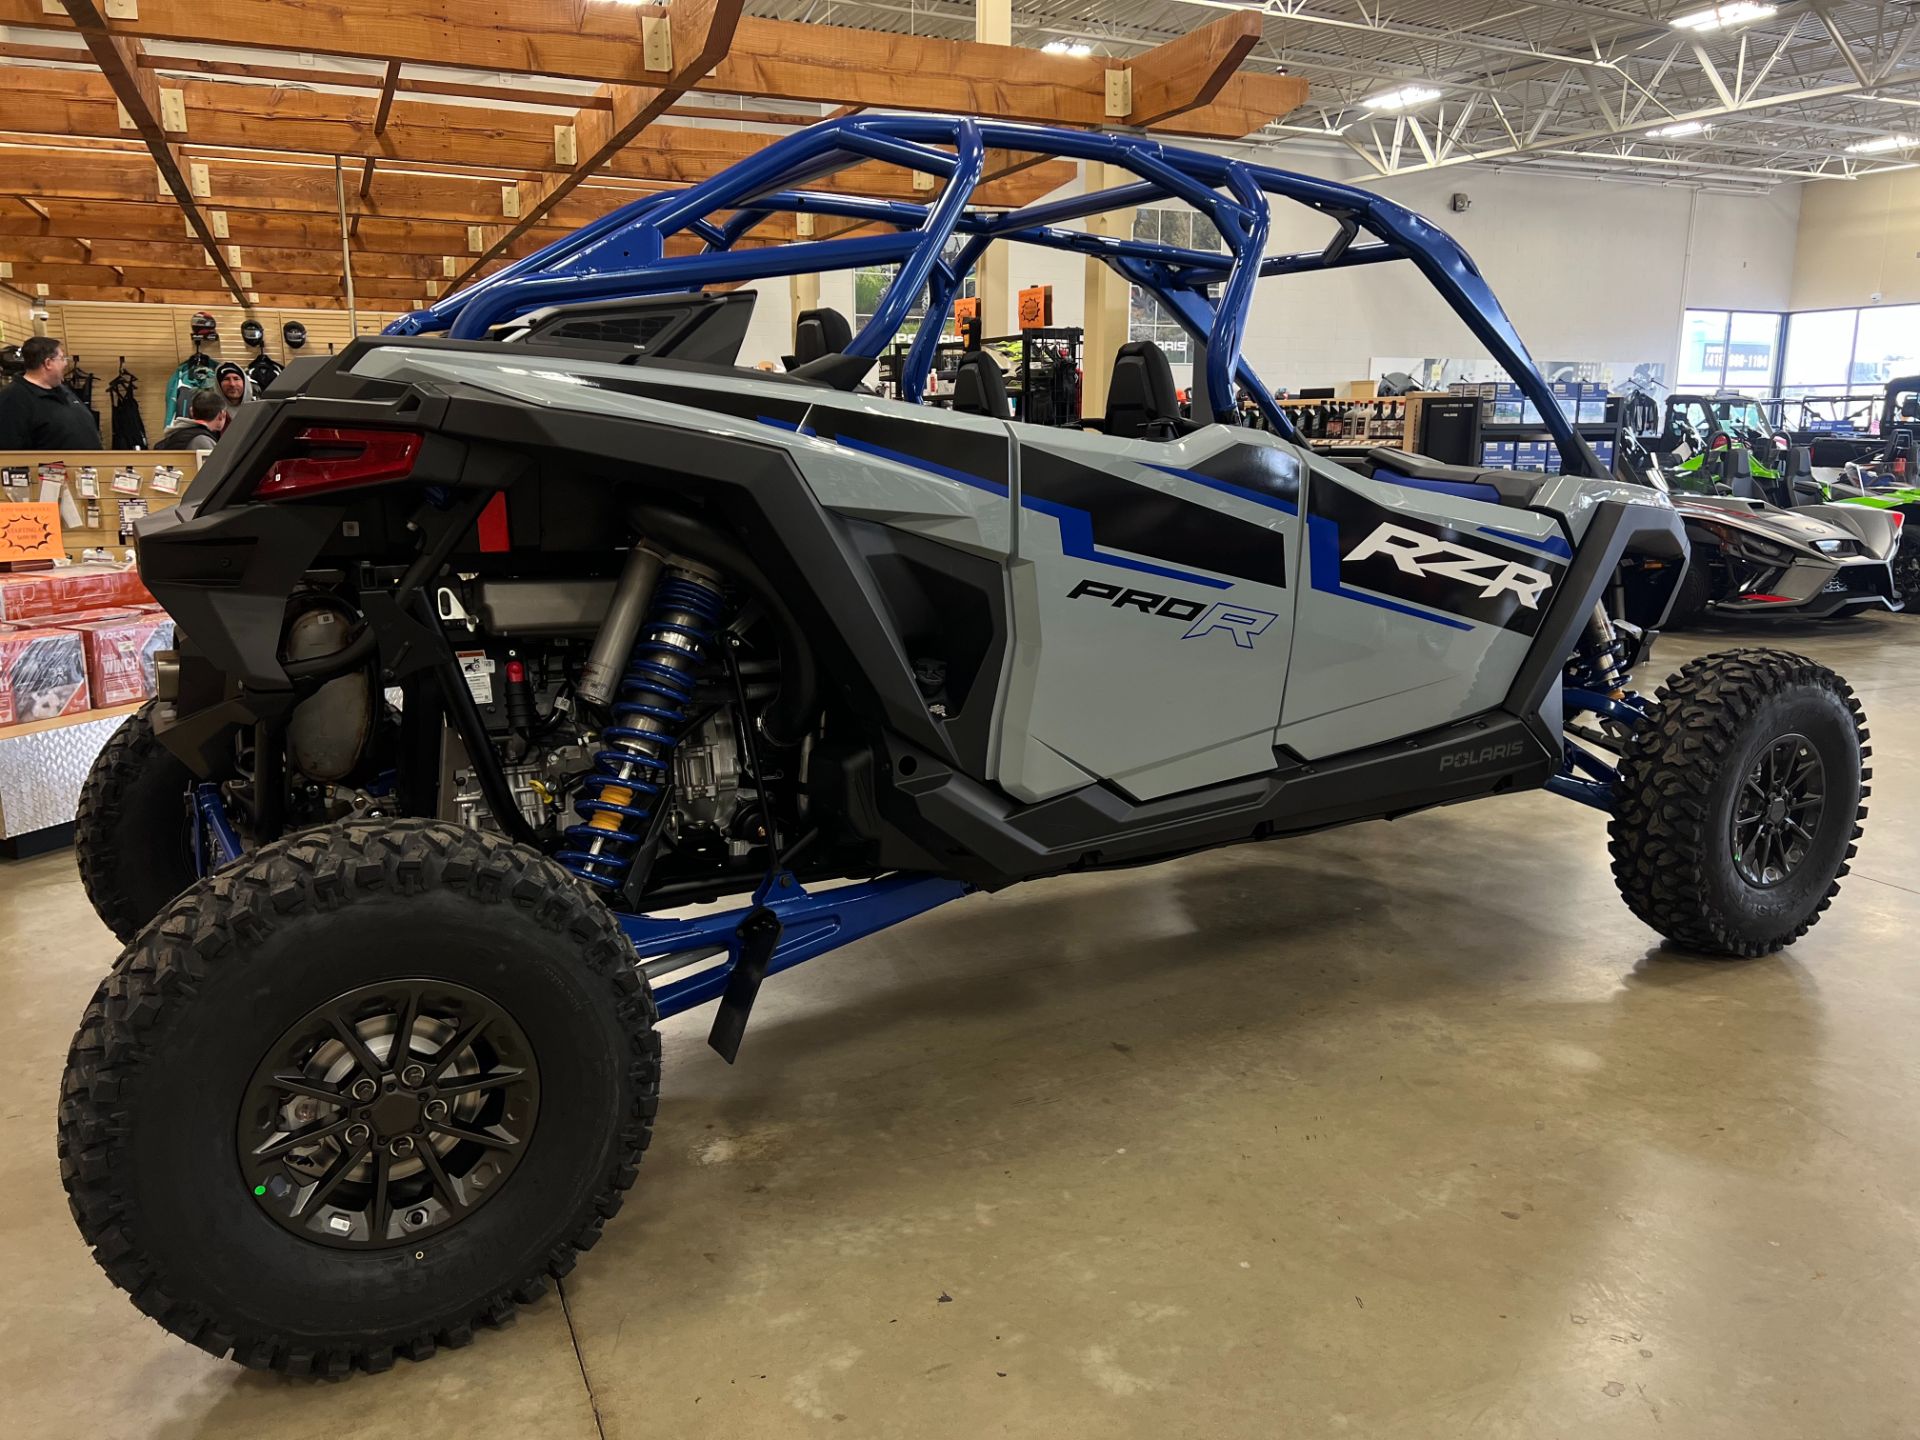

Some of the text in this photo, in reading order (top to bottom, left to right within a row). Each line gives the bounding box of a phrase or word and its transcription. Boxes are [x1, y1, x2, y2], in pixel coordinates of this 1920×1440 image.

[1342, 522, 1553, 610] RZR
[1066, 579, 1279, 649] PRO R
[103, 658, 138, 674] WINCH
[1440, 740, 1524, 772] POLARIS
